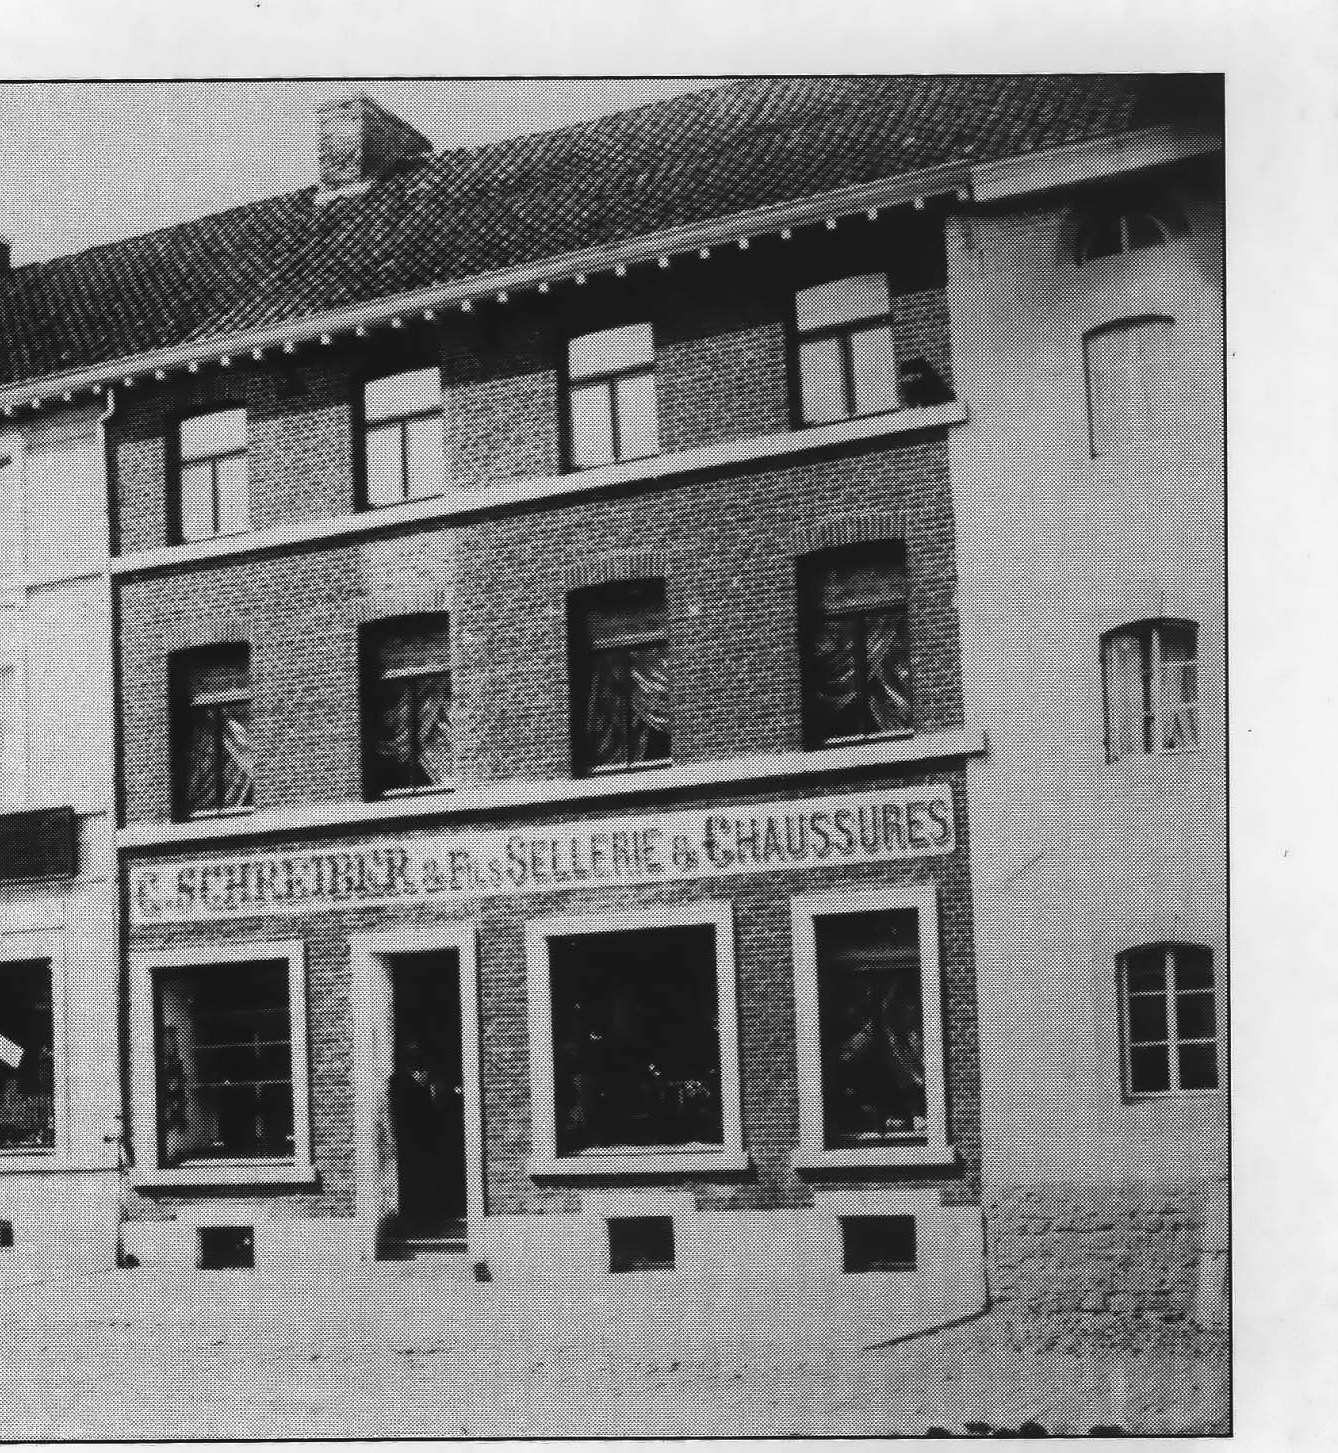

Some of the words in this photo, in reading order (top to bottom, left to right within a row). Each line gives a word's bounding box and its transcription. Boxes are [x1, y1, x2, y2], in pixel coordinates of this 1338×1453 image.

[176, 847, 418, 913] SCHREIBER
[505, 827, 663, 888] SELLERIE
[702, 798, 952, 869] CHAUSSURES
